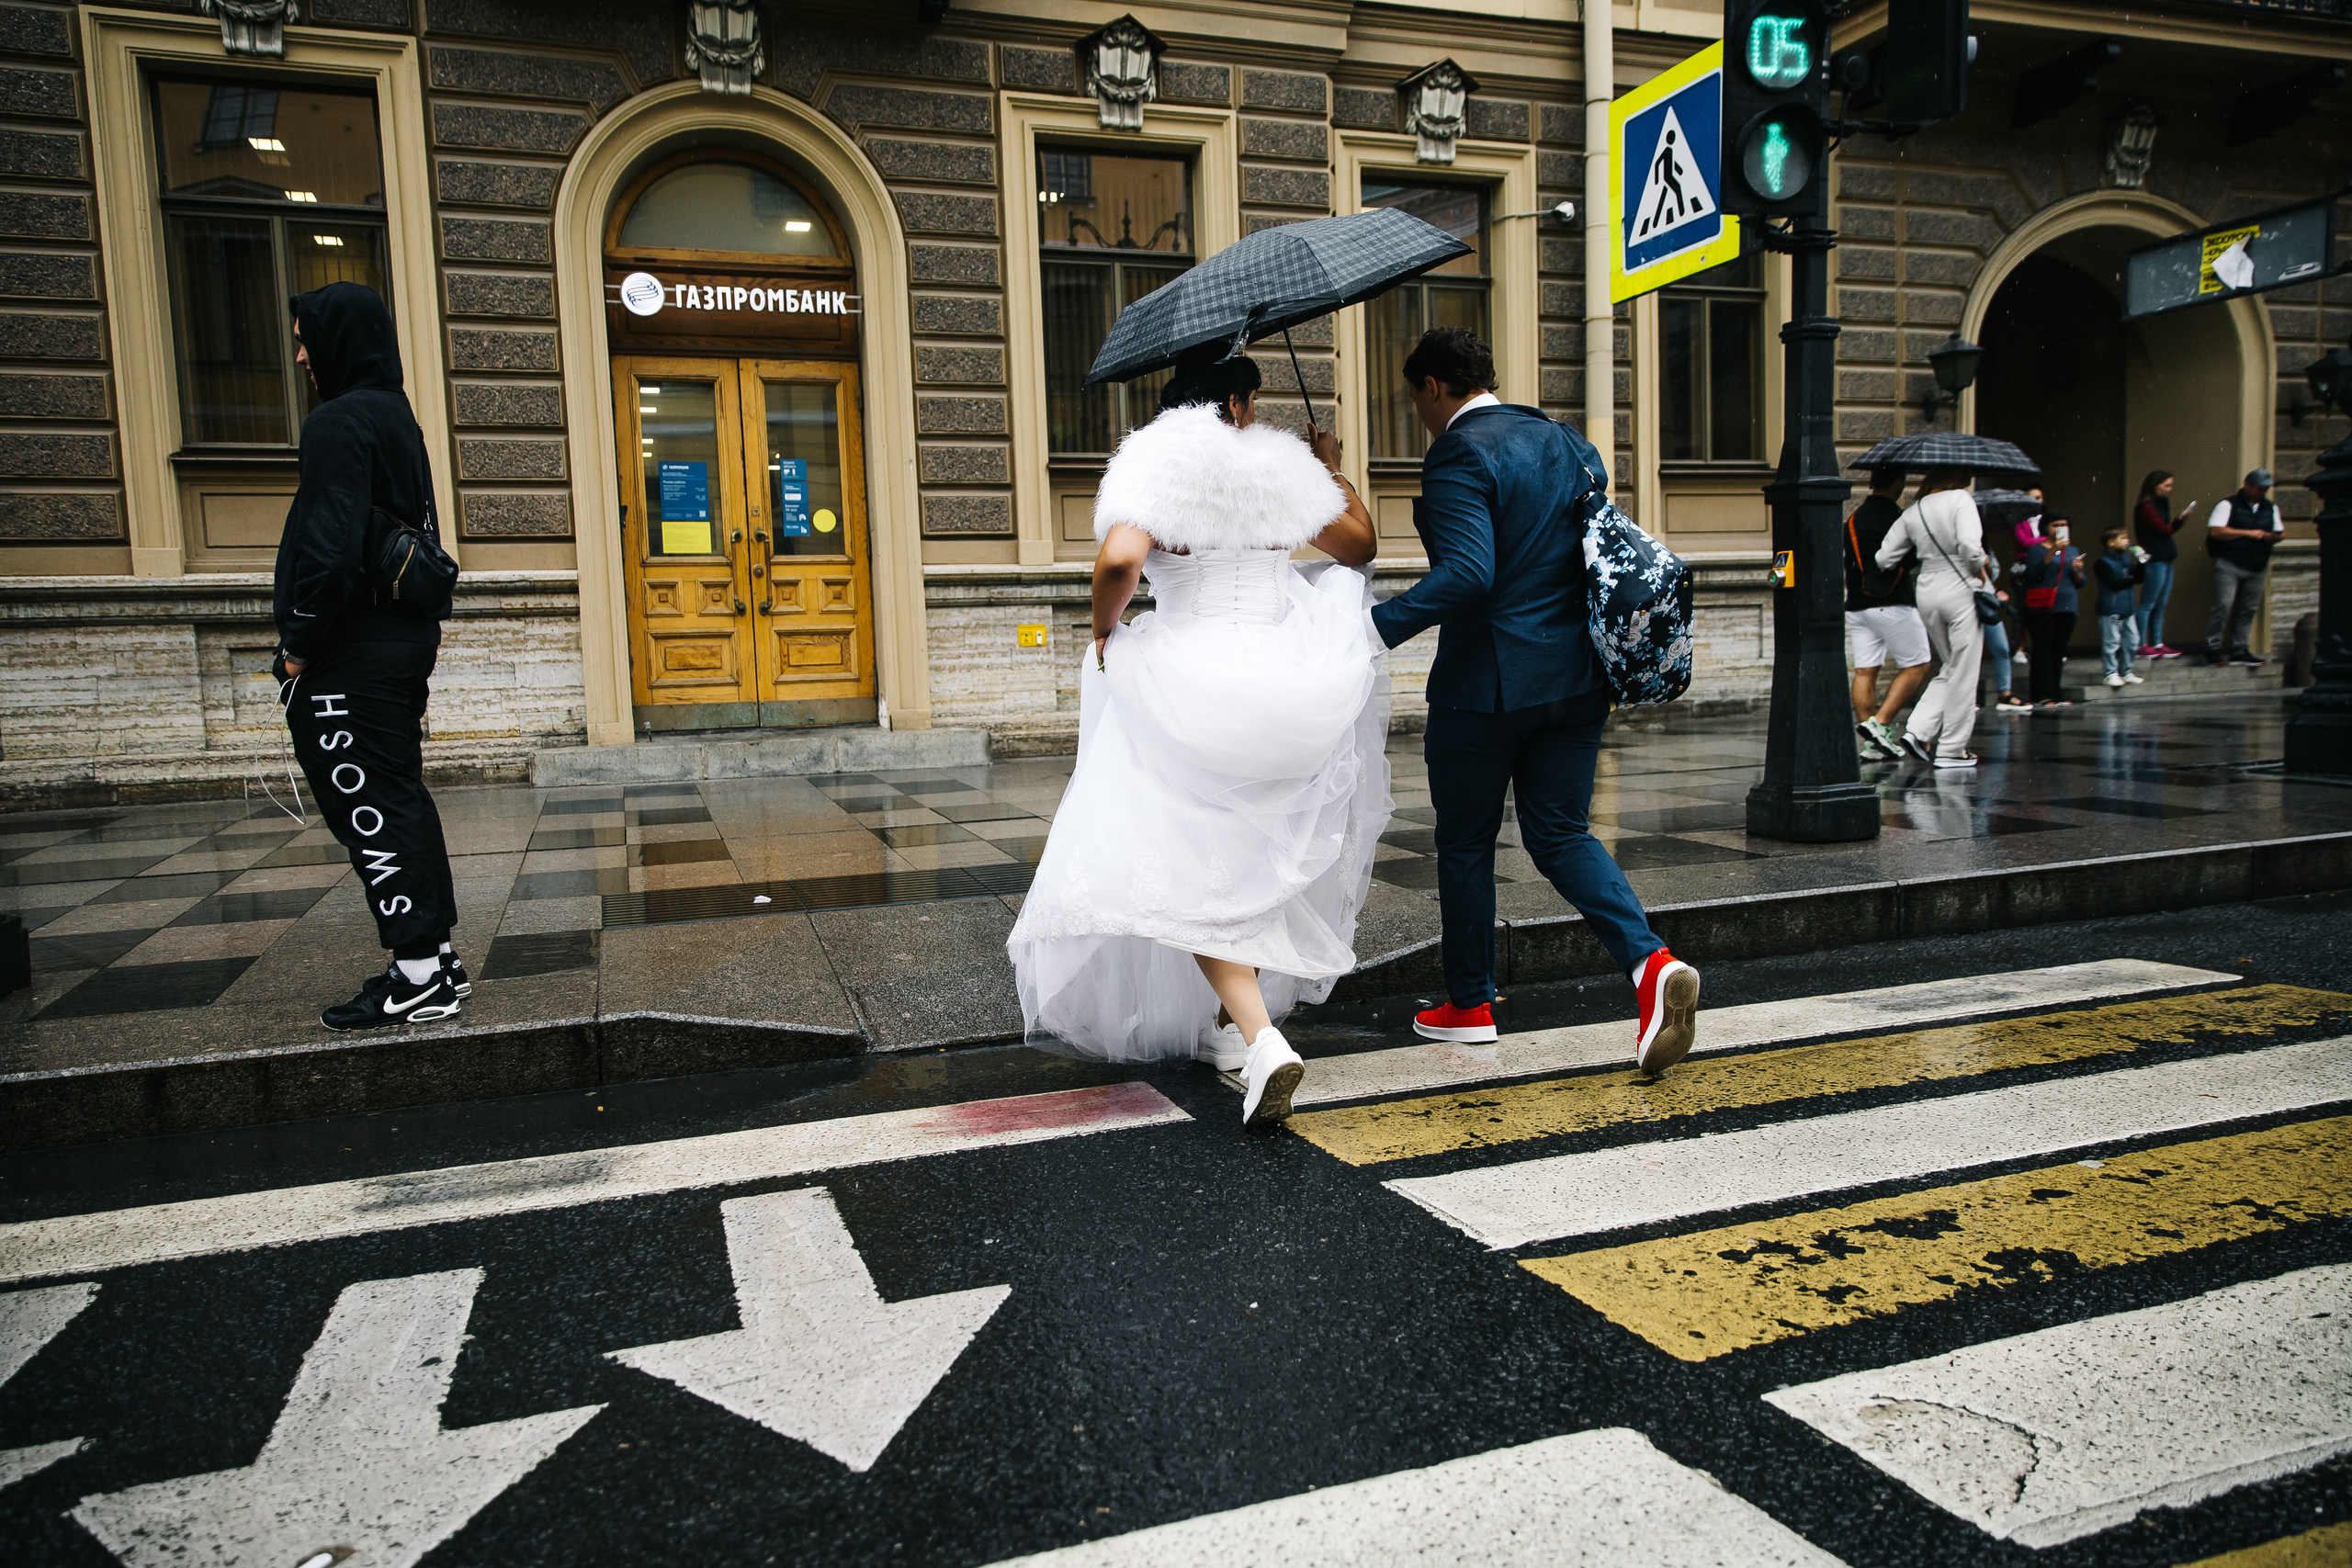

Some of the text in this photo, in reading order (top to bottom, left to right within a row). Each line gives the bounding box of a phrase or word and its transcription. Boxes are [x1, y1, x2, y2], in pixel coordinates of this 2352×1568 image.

[1749, 16, 1808, 78] 05
[675, 284, 848, 314] ГАЗПРОМБАНК
[311, 694, 412, 916] SWOOSH
